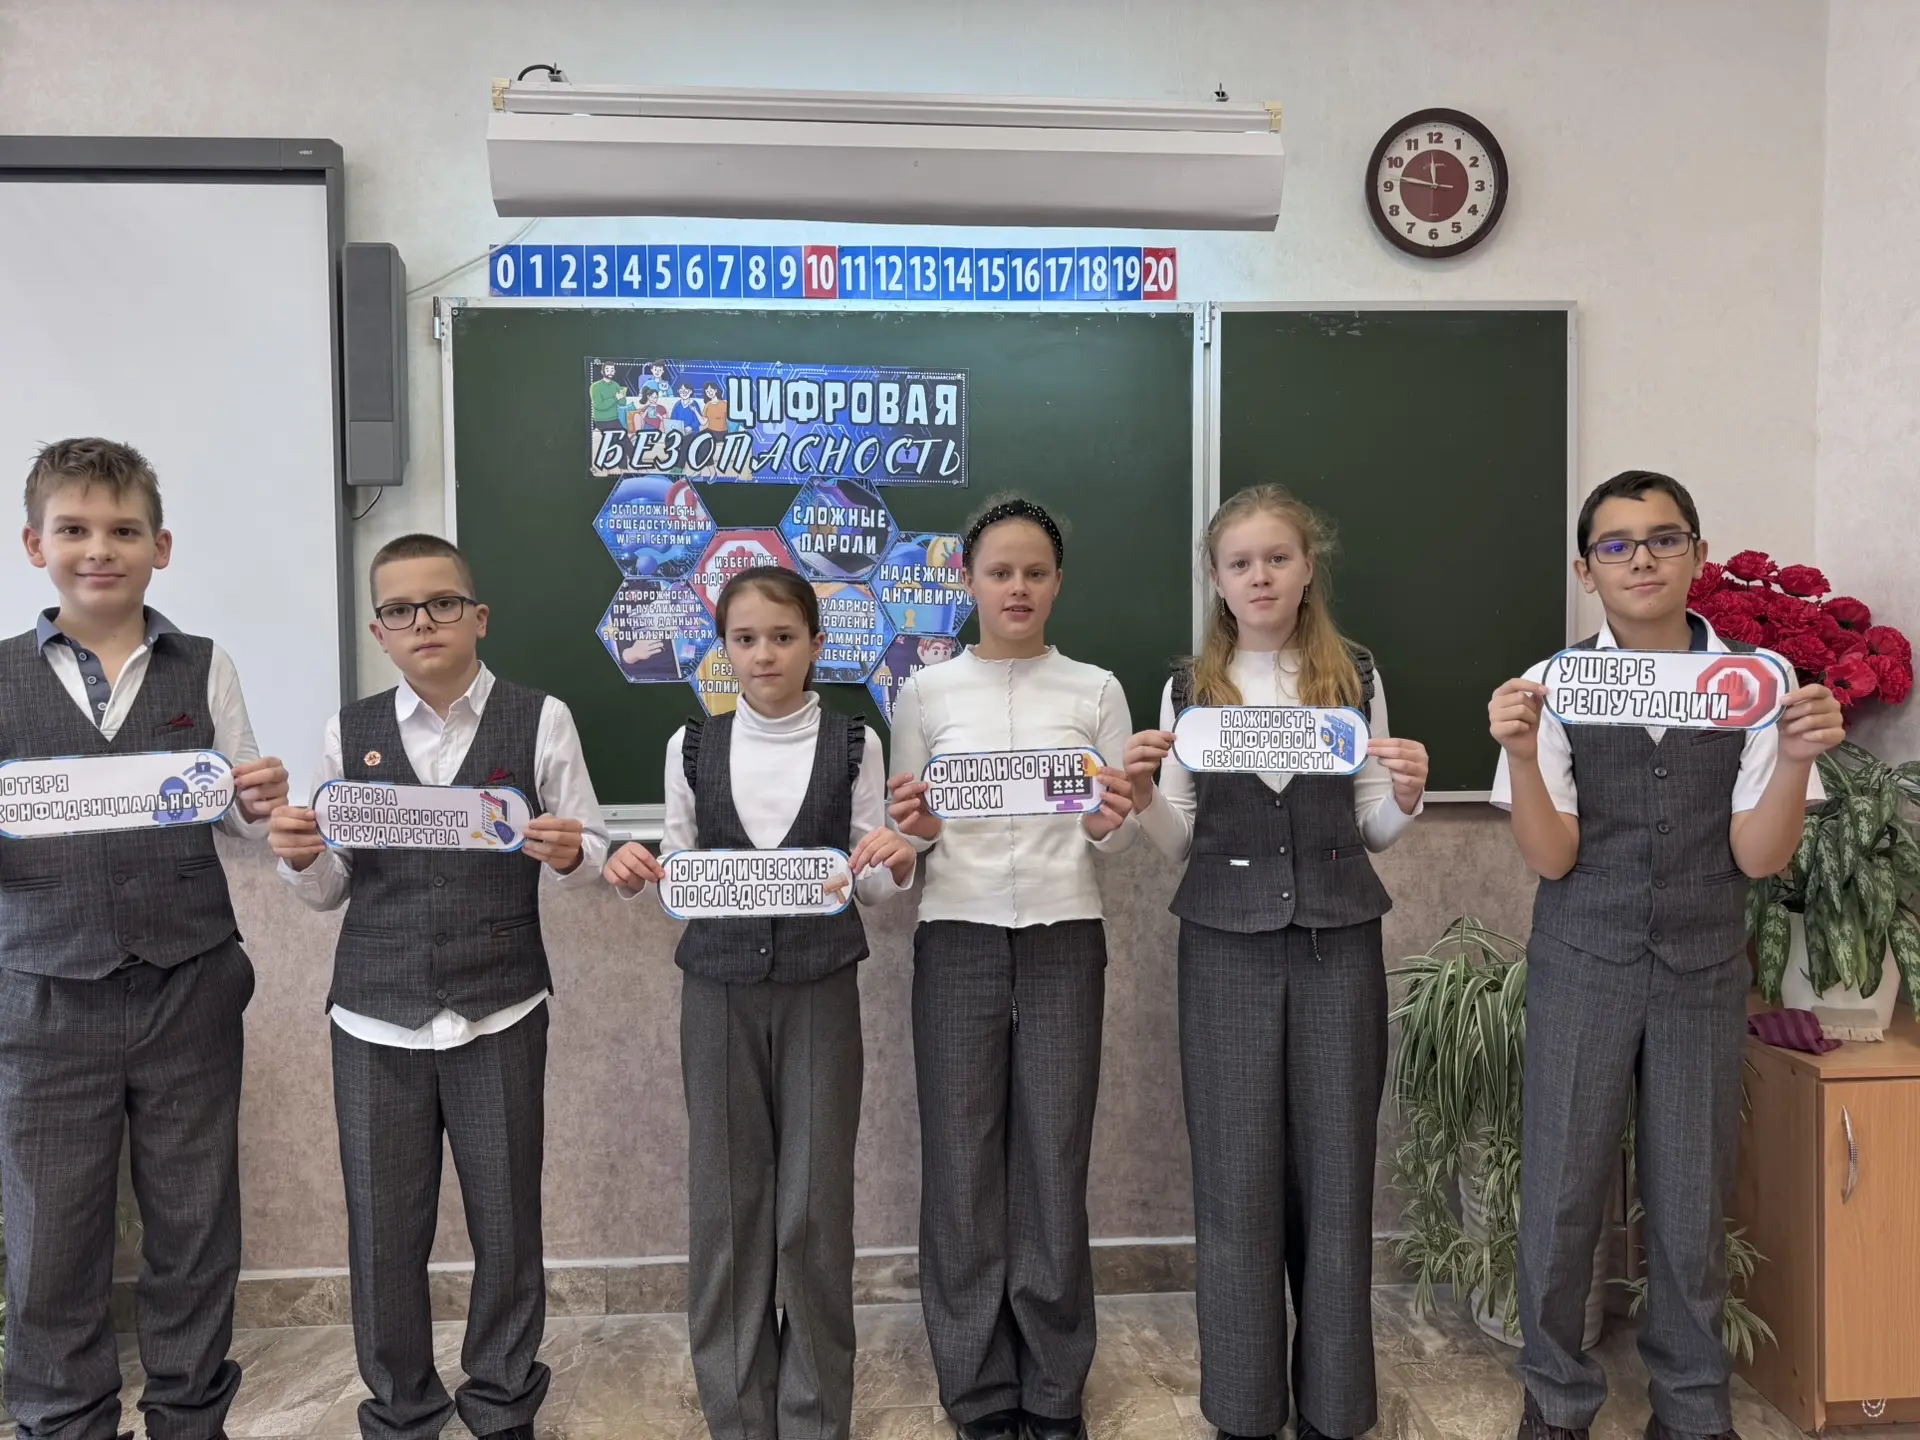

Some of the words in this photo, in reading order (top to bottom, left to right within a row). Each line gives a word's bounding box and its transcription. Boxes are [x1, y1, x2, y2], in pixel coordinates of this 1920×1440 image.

[1405, 139, 1419, 150] 11
[1427, 132, 1443, 144] 12
[1455, 139, 1461, 150] 1
[1387, 156, 1403, 168] 10
[1469, 156, 1479, 168] 2
[1383, 181, 1394, 192] 9
[1474, 180, 1485, 192] 3
[1389, 205, 1400, 216] 8
[1467, 204, 1478, 215] 4
[1406, 222, 1416, 234] 7
[1428, 228, 1439, 240] 6
[1451, 222, 1462, 234] 5
[497, 254, 515, 288] 0
[529, 254, 543, 289] 1
[560, 254, 577, 289] 2
[592, 254, 608, 289] 3
[623, 255, 642, 289] 4
[655, 255, 671, 289] 5
[686, 255, 704, 290] 6
[717, 255, 734, 290] 7
[749, 255, 766, 290] 8
[779, 255, 797, 290] 9
[807, 256, 834, 290] 10
[841, 256, 866, 290] 11
[875, 256, 903, 291] 12
[909, 256, 937, 291] 13
[943, 256, 972, 291] 14
[978, 256, 1005, 291] 15
[1011, 256, 1040, 291] 16
[1045, 257, 1073, 292] 17
[1079, 257, 1107, 292] 18
[1112, 257, 1140, 292] 19
[1143, 257, 1173, 292] 20
[727, 377, 958, 428] ЦИФРОВАЯ
[595, 429, 961, 477] БЕЗОПАСНОСТЬ
[611, 504, 696, 516] ОСТОРОЖНОСТЬ
[793, 505, 886, 528] СЛОЖНЫЕ
[599, 519, 604, 529] С
[609, 519, 712, 531] ОБЩЕДОСТУПНЫМИ
[650, 534, 692, 545] СЕТЯМИ
[801, 533, 876, 554] ПАРОЛИ
[715, 553, 778, 568] ИЗБЕГАЙТЕ
[880, 563, 960, 583] НАДЁЖНЫ
[619, 590, 695, 601] ОСТОРОЖНОСТЬ
[613, 604, 632, 614] ПРИ
[636, 604, 701, 615] ПУБЛИКАЦИИ
[818, 599, 875, 612] УЛЯРНОЕ
[613, 617, 654, 627] ЛИЧНЫХ
[659, 617, 700, 627] ДАННЫХ
[819, 615, 875, 629] ОВЛЕНИЕ
[603, 631, 609, 640] В
[613, 630, 679, 640] СОЦИАЛЬНЫХ
[683, 630, 713, 639] СЕТЯХ
[827, 632, 884, 646] АММНОГО
[819, 649, 876, 662] ПЕЧЕНИЯ
[1559, 656, 1656, 686] УШЕРБ
[698, 678, 739, 693] КОПИЙ
[1556, 688, 1729, 722] РЕПУТАЦИИ
[1220, 710, 1316, 728] ВАЖНОСТЬ
[1220, 728, 1316, 750] ЦИФРОВОЙ
[1202, 750, 1335, 770] БЕЗОПАСНОСТИ
[929, 754, 1084, 783] ФИНАНСОВЫЕ
[0, 774, 69, 796] ОТЕРЯ
[327, 785, 397, 806] УГРОЗА
[930, 785, 1003, 811] РИСКИ
[328, 805, 469, 827] БЕЗОПАСНОСТИ
[329, 824, 460, 846] ГОСУДАРСТВА
[670, 858, 828, 884] ЮРИДИЧЕСКИЕ
[671, 883, 824, 909] ПОСЛЕДСТВИЯ
